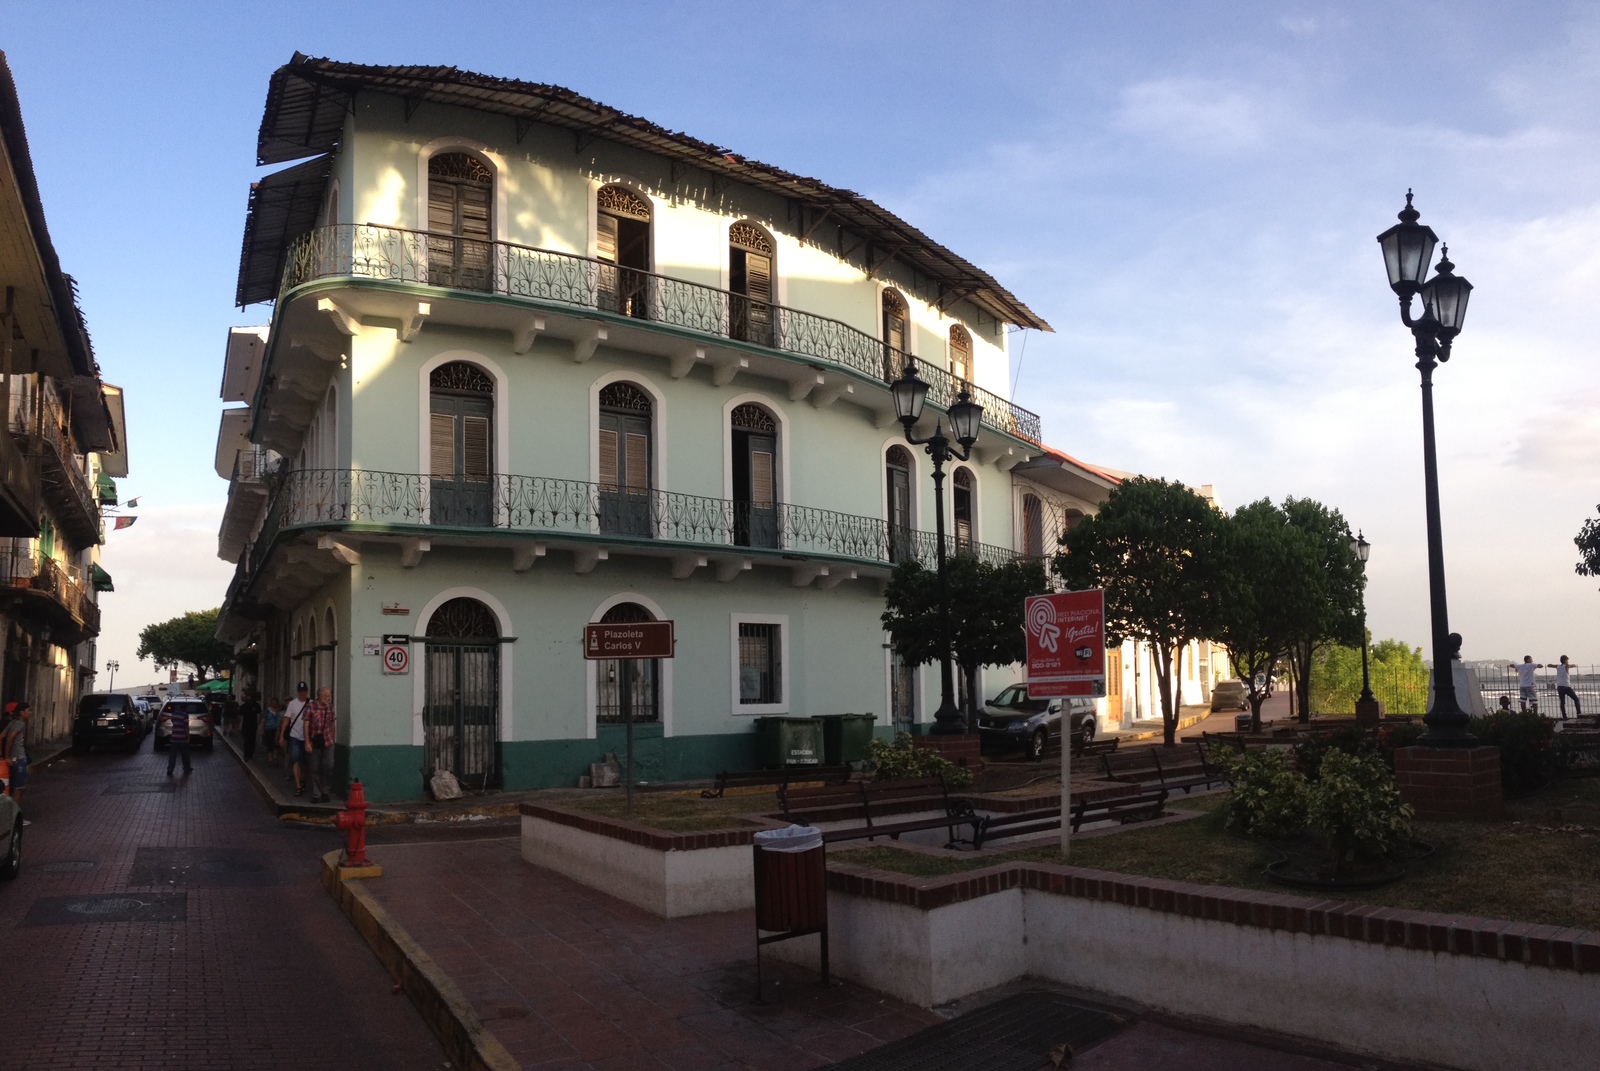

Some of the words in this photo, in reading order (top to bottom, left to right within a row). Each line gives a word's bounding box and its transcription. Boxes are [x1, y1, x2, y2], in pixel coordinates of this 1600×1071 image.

[1057, 615, 1089, 623] INTERNET
[604, 630, 644, 639] Plazoleta
[604, 641, 633, 650] Carlos
[634, 641, 641, 650] V
[389, 652, 403, 663] 40
